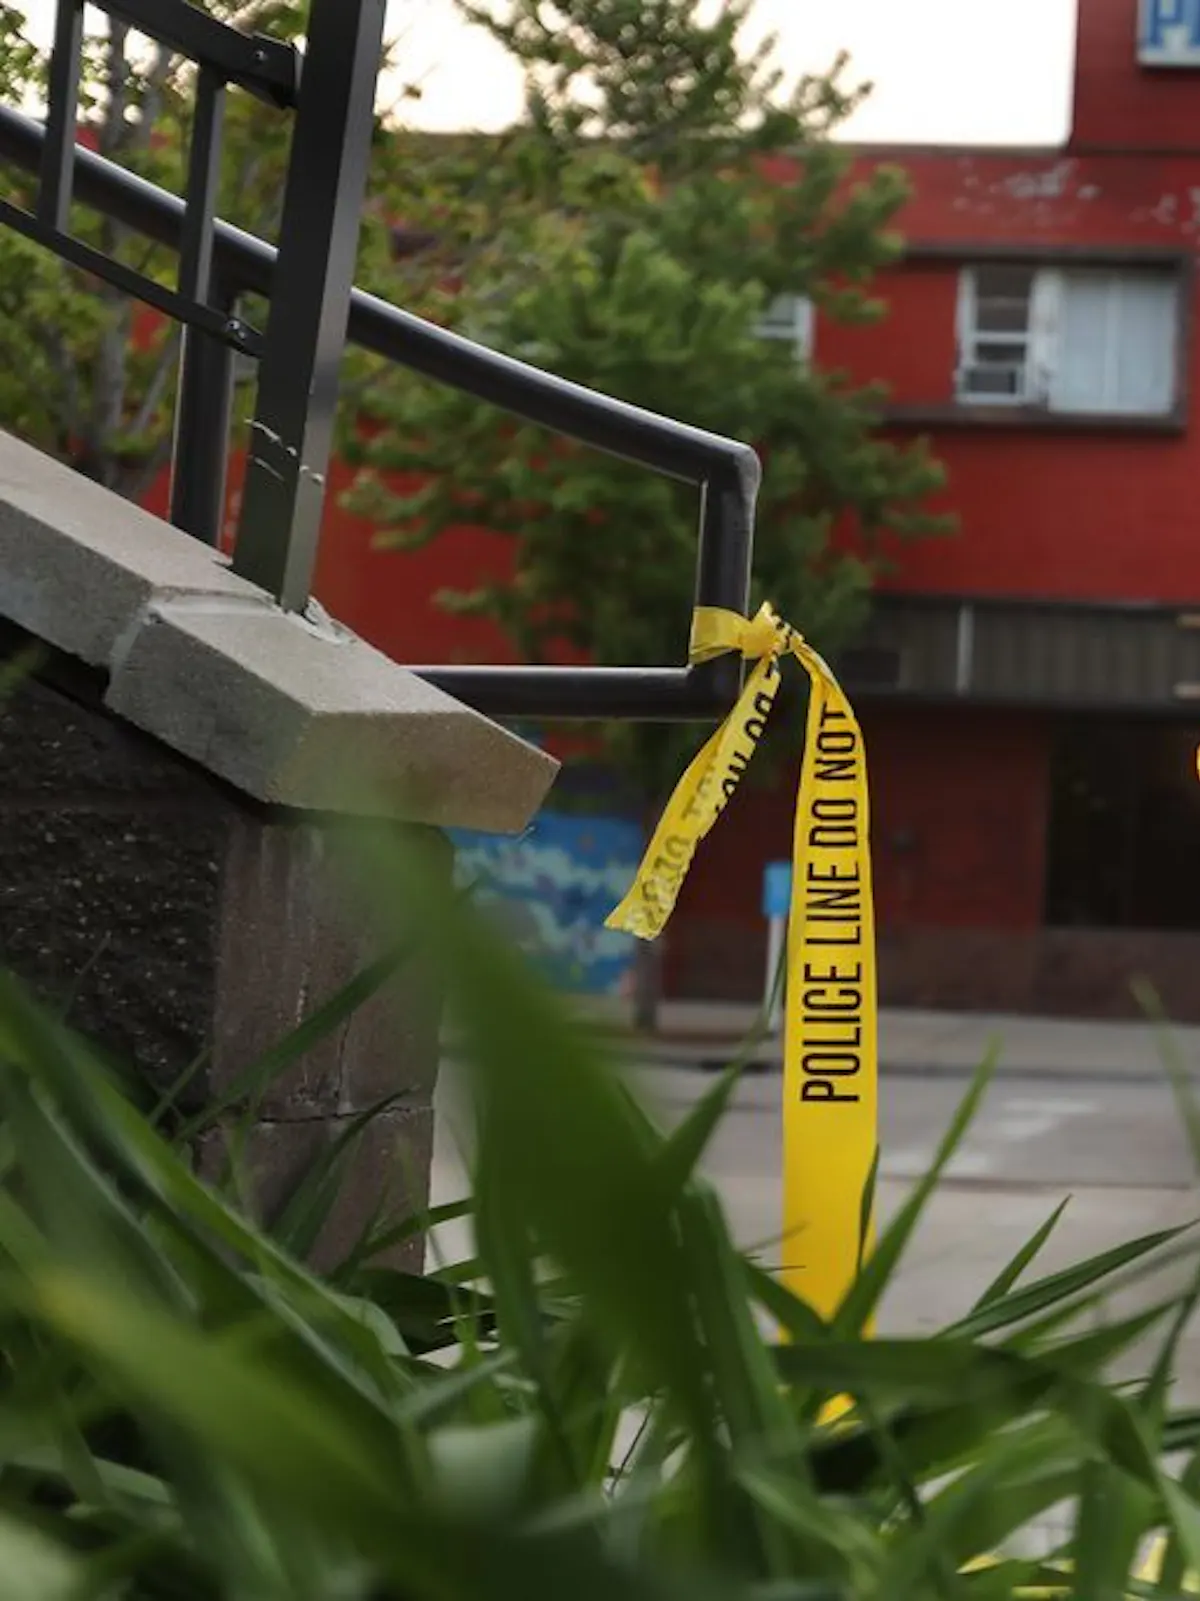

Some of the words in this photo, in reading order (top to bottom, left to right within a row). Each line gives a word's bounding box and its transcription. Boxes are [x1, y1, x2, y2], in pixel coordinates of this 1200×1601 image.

[813, 701, 857, 780] NOT
[809, 799, 857, 846] DO
[805, 862, 861, 945] LINE
[801, 962, 862, 1102] POLICE
